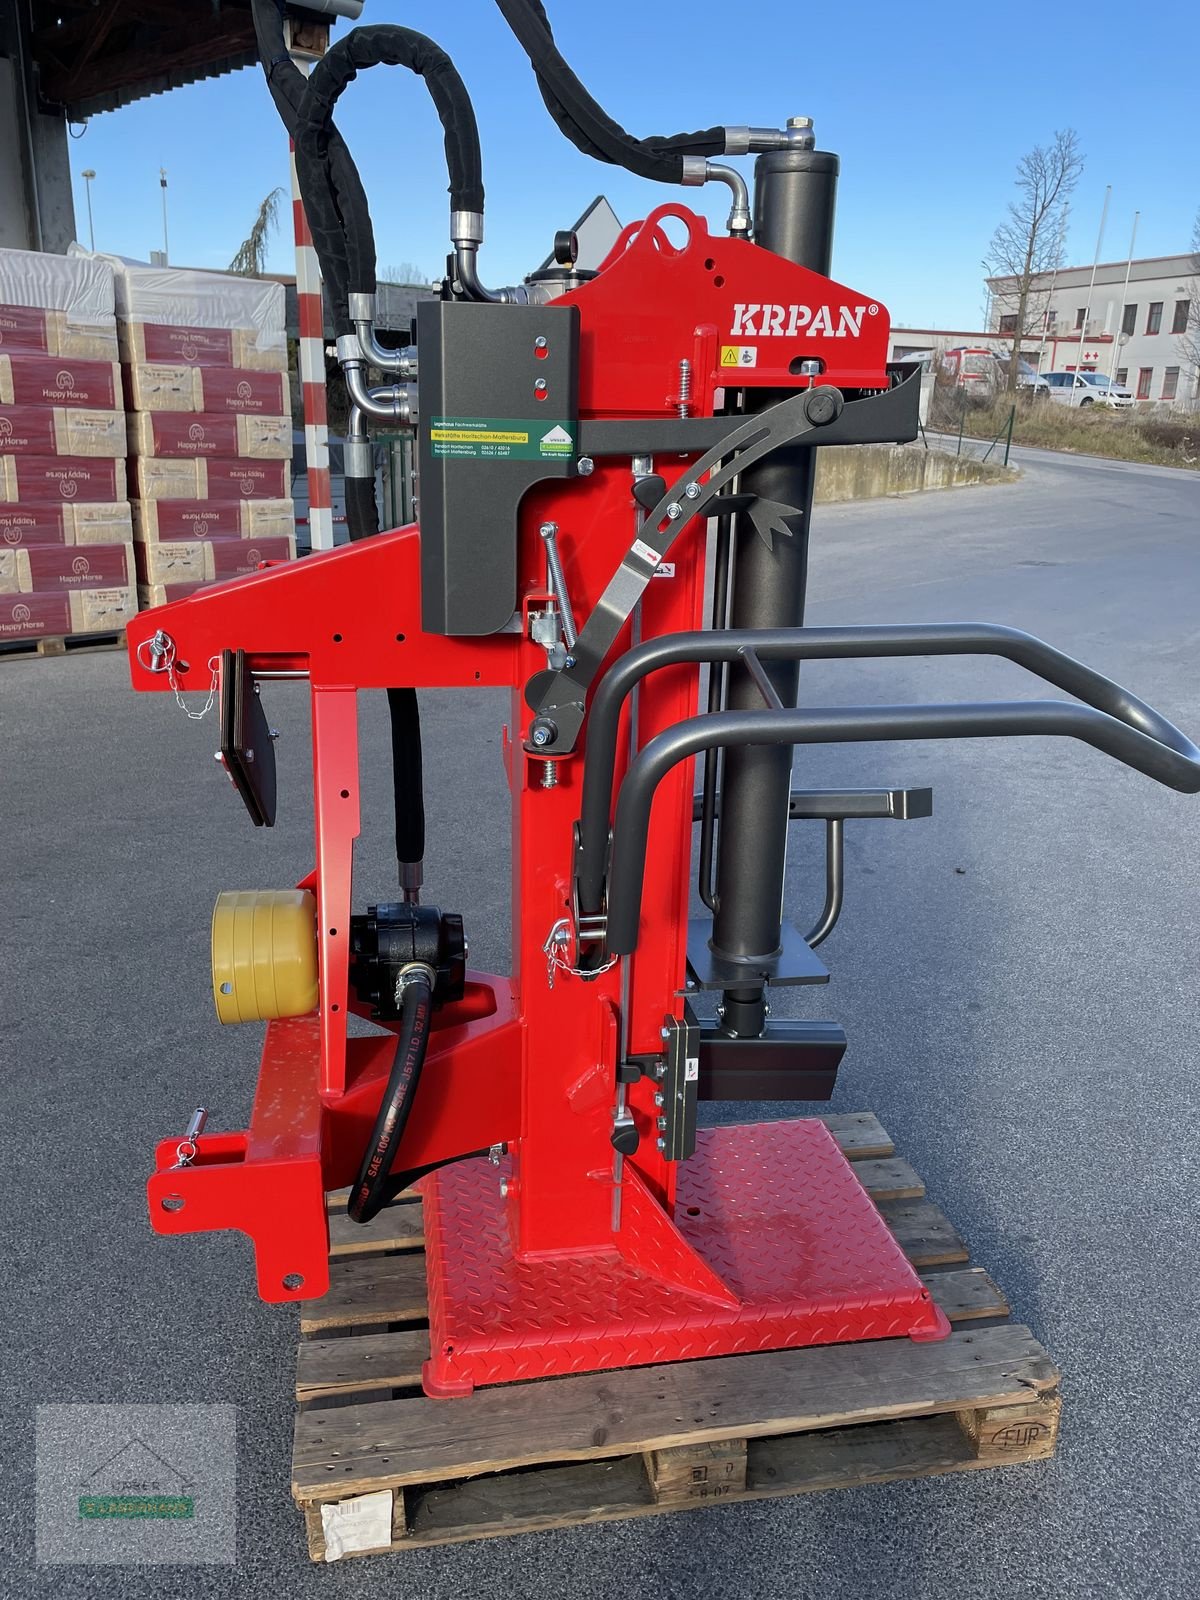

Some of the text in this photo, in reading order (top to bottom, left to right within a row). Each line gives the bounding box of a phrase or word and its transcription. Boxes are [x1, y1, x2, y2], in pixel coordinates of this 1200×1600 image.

[42, 389, 88, 400] Happy Horse
[226, 398, 262, 408] Happy Horse
[5, 437, 28, 446] Horse
[177, 441, 196, 450] Happy
[46, 470, 91, 479] Happy Horse
[247, 470, 265, 479] Happy
[13, 518, 36, 527] Happy
[201, 513, 219, 521] Happy
[60, 573, 103, 584] Happy Horse
[0, 621, 45, 632] Happy Horse
[415, 1020, 426, 1034] 32
[410, 1036, 421, 1052] I.D.
[402, 1053, 417, 1082] J517
[393, 1082, 409, 1109] SAE
[367, 1154, 383, 1178] SAE
[1004, 1427, 1040, 1447] EUR
